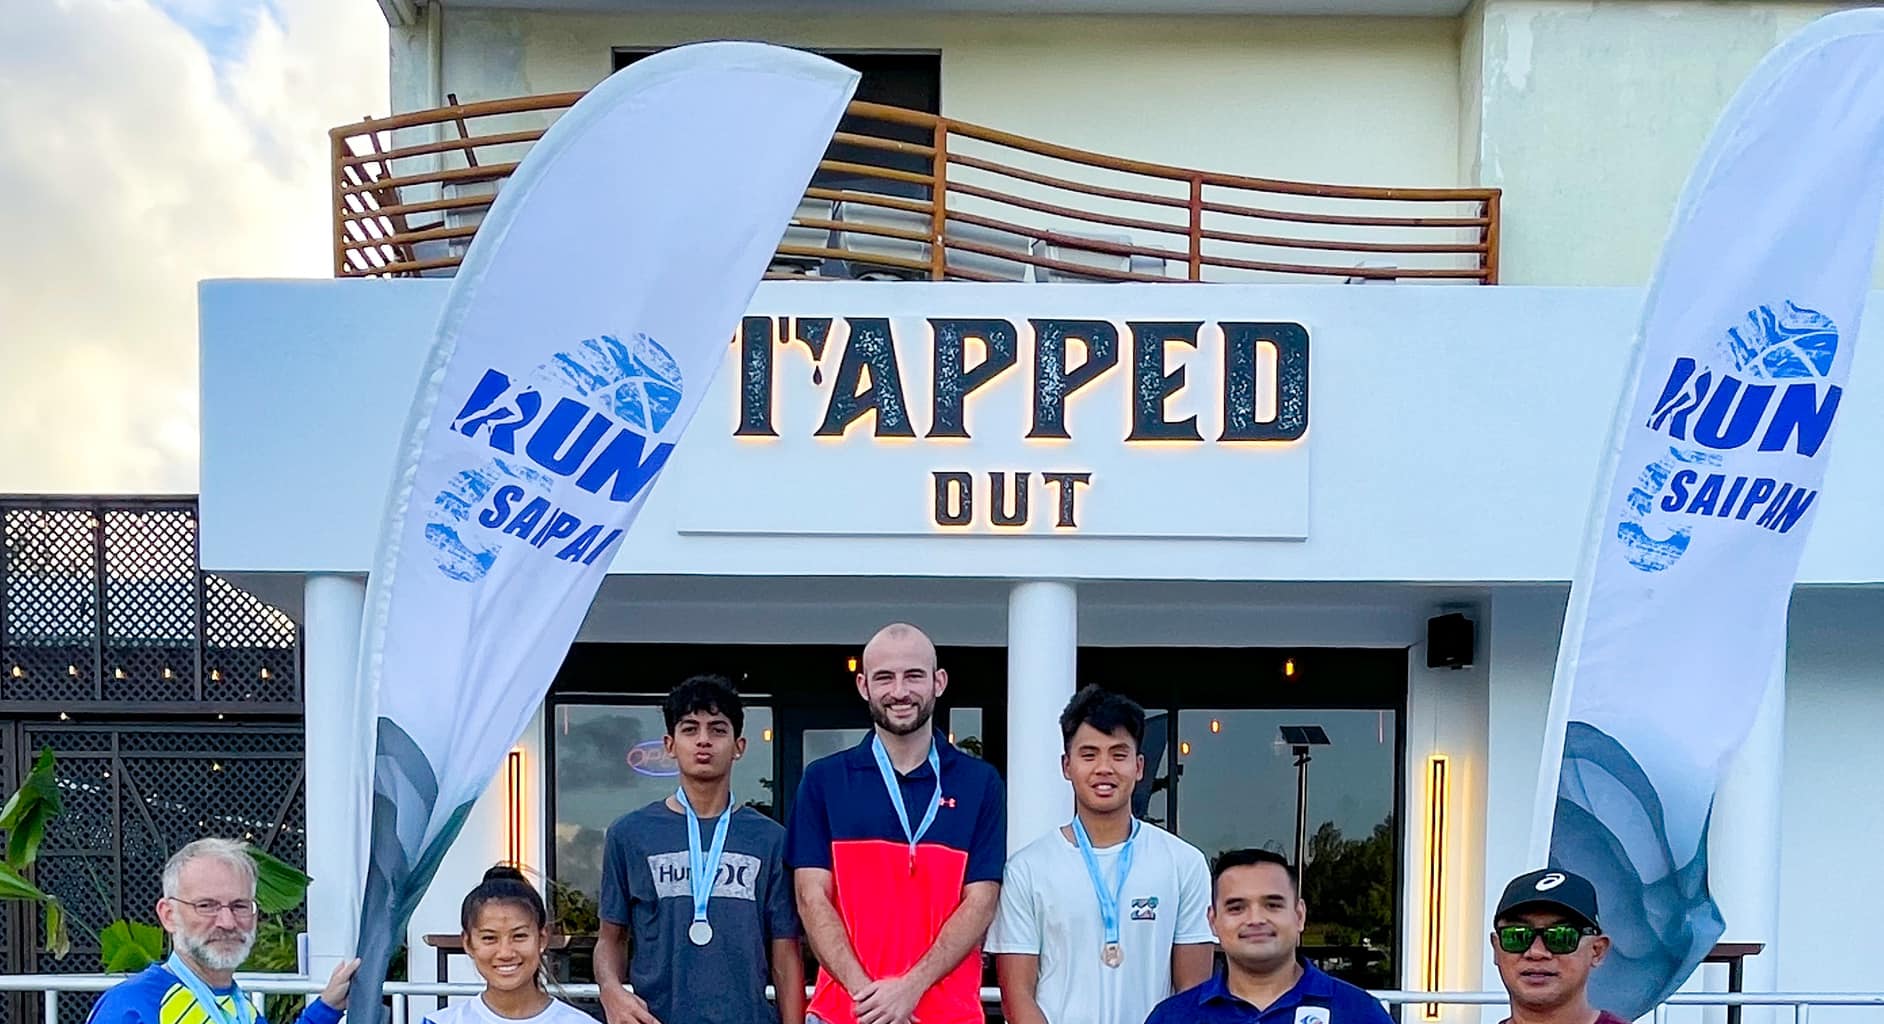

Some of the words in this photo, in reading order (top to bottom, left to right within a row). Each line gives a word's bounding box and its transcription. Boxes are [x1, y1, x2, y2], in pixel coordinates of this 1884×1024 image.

[731, 315, 1311, 442] TAPPED
[1645, 356, 1844, 458] RUN
[449, 367, 676, 503] RUN
[931, 471, 1093, 528] OUT
[1660, 468, 1818, 534] SAIPAN
